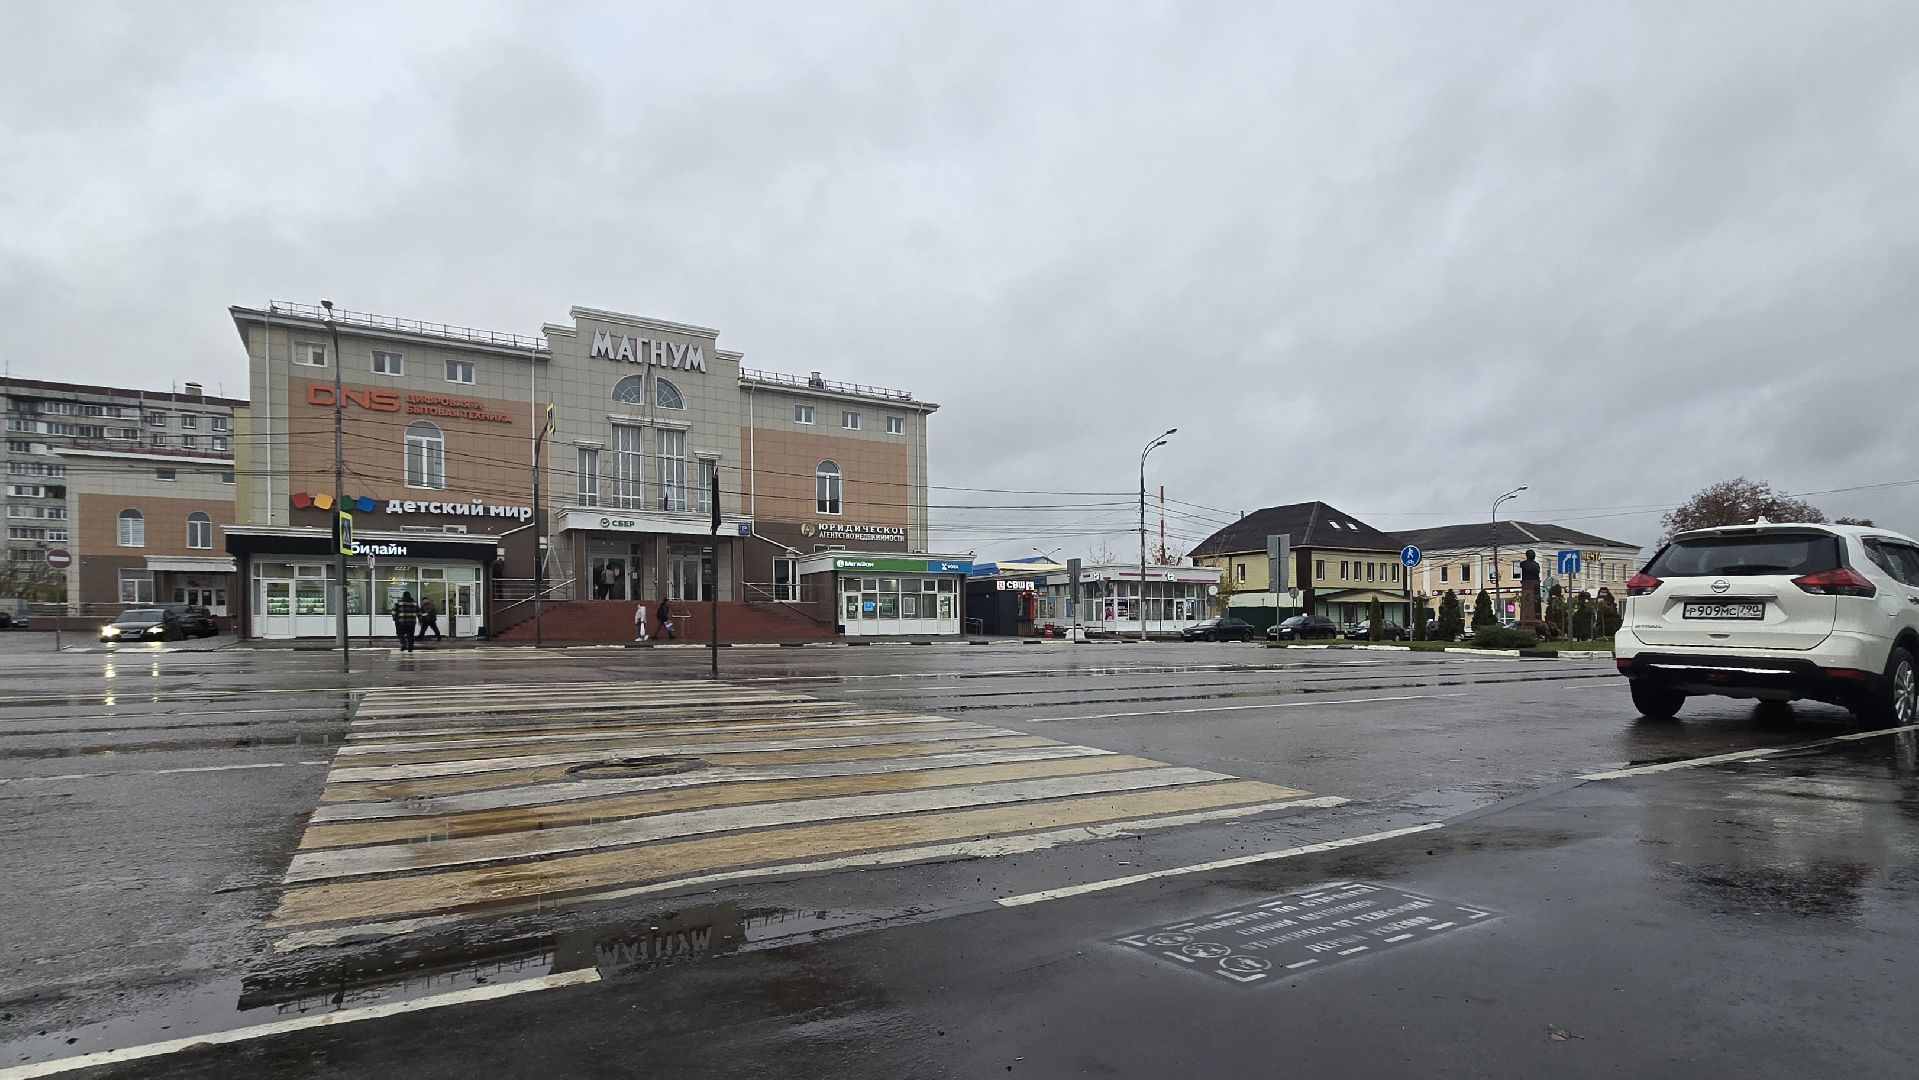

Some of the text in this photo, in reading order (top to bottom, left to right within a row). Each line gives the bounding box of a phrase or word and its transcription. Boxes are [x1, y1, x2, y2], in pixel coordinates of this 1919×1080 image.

[590, 327, 707, 373] МАГНУМ
[307, 383, 400, 412] DNS
[406, 394, 472, 408] ЦИФРОВАЯ
[406, 404, 513, 424] БЫТОВАЯ ТЕХНИКА
[386, 498, 532, 522] детский мир
[612, 520, 635, 528] СБЕР
[818, 523, 905, 535] ЮРИДИЧЕСКОЕ
[819, 531, 905, 542] АГЕНТСТВО НЕДВИЖИМОСТИ
[350, 541, 407, 556] билайн
